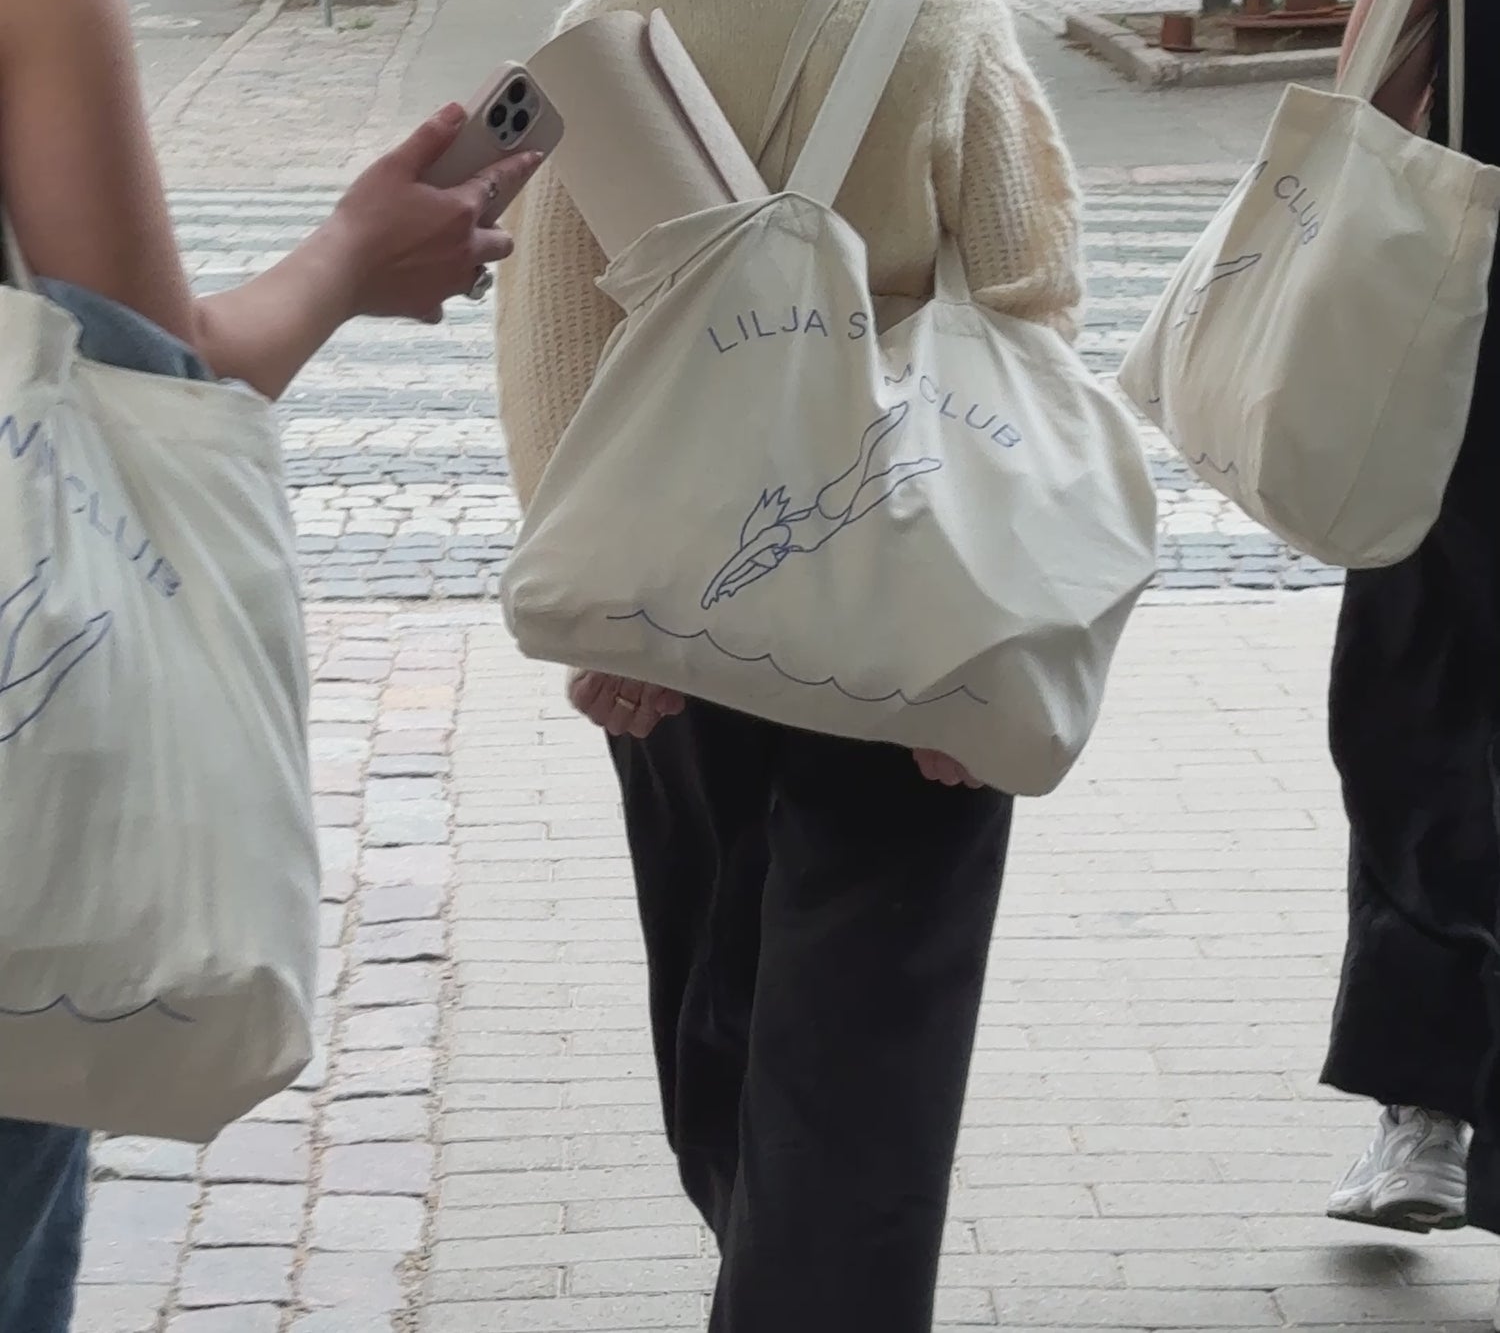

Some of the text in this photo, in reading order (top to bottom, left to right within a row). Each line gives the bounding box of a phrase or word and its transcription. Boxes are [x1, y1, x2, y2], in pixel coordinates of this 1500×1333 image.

[1273, 174, 1320, 246] CLUB
[707, 304, 829, 354] LILJA
[918, 374, 1022, 448] CLUB
